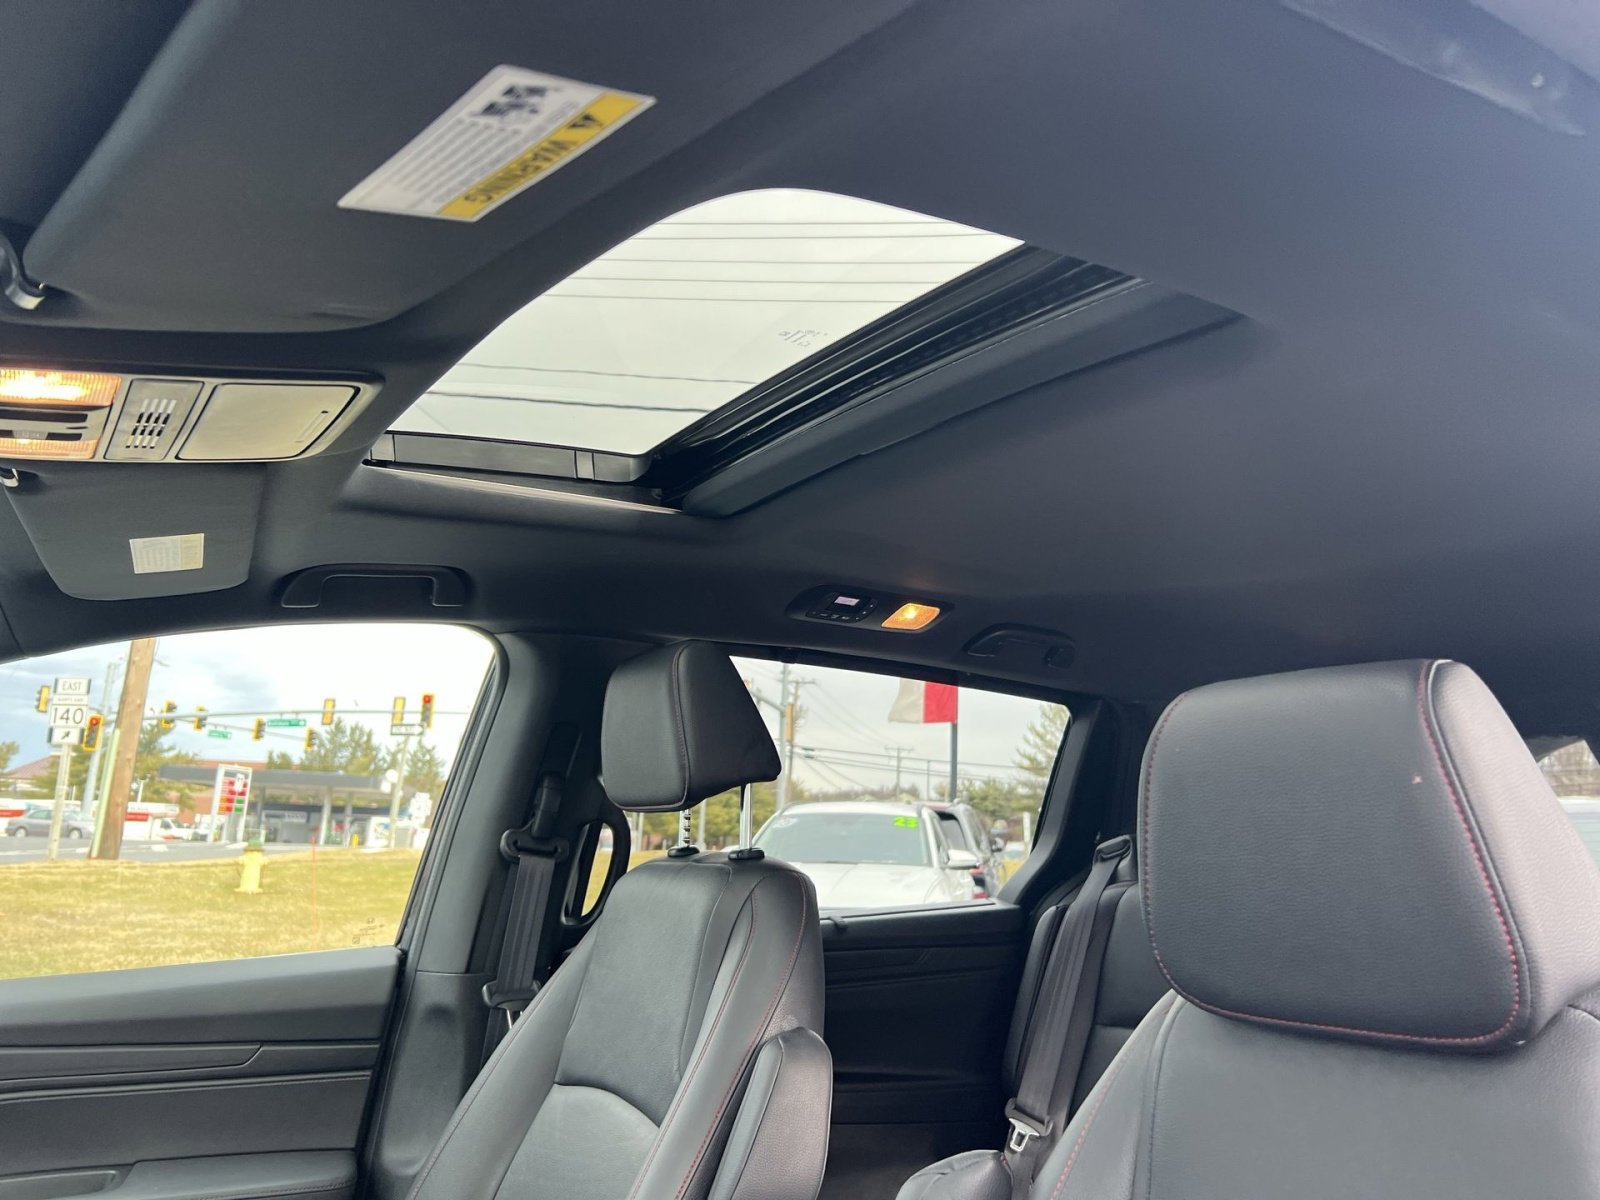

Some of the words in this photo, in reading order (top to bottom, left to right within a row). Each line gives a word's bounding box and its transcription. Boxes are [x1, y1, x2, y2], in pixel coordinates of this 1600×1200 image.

[463, 139, 572, 203] WARNING
[62, 681, 82, 691] EAST
[53, 707, 84, 725] 140
